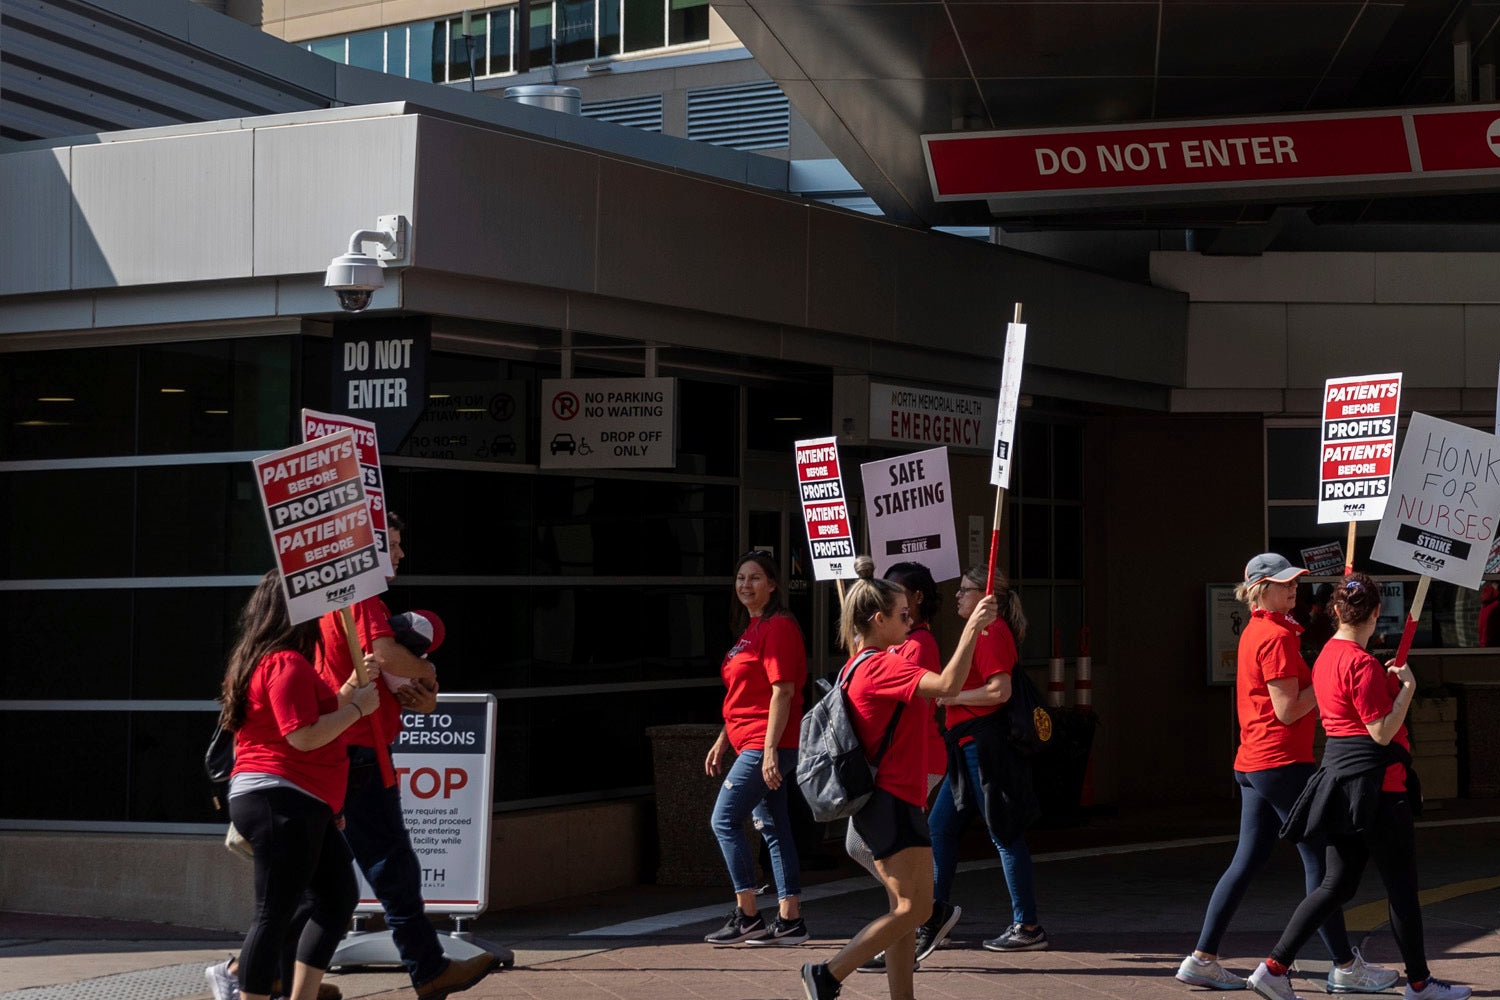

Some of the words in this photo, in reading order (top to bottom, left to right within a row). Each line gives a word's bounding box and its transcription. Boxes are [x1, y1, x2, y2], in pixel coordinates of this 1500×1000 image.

[1035, 147, 1086, 175] DO
[1096, 142, 1169, 172] NOT
[1181, 136, 1298, 168] ENTER
[344, 342, 369, 371] DO
[375, 339, 413, 369] NOT
[348, 378, 407, 409] ENTER
[585, 393, 604, 404] NO
[608, 391, 664, 404] PARKING
[1327, 382, 1399, 403] PATIENTS
[585, 407, 604, 418] NO
[607, 406, 664, 418] WAITING
[892, 391, 917, 408] NORTH
[919, 394, 954, 412] MEMORIAL
[956, 399, 981, 415] HEALTH
[1342, 403, 1381, 416] BEFORE
[306, 420, 375, 447] PATNTS
[601, 431, 635, 443] DROP
[638, 431, 662, 442] OFF
[891, 410, 981, 445] EMERGENCY
[1328, 419, 1391, 439] PROFITS
[614, 445, 649, 457] ONLY
[798, 446, 836, 464] PATIENTS
[1324, 442, 1393, 463] PATIENTS
[263, 441, 353, 486] PATIENTS
[888, 459, 925, 487] SAFE
[1338, 463, 1376, 476] BEFORE
[288, 468, 338, 495] BEFORE
[803, 482, 840, 499] PROFITS
[1325, 479, 1386, 499] PROFITS
[1422, 473, 1478, 508] FOR
[276, 483, 359, 526] PROFITS
[873, 482, 945, 517] STAFFING
[806, 505, 846, 522] PATIENTS
[1396, 493, 1493, 541] NURSES
[279, 508, 368, 555] PATIENTS
[304, 536, 354, 563] BEFORE
[813, 540, 851, 557] PROFITS
[901, 540, 929, 553] STRIKE
[1416, 534, 1452, 554] STRIKE
[292, 551, 374, 594] PROFITS
[430, 714, 452, 728] TO
[399, 731, 475, 745] PERSONS
[396, 766, 468, 799] TOP
[405, 818, 420, 826] top,
[439, 818, 472, 826] proceed
[416, 809, 447, 817] requires
[413, 836, 439, 845] facility
[441, 836, 462, 844] while
[428, 828, 460, 837] entering
